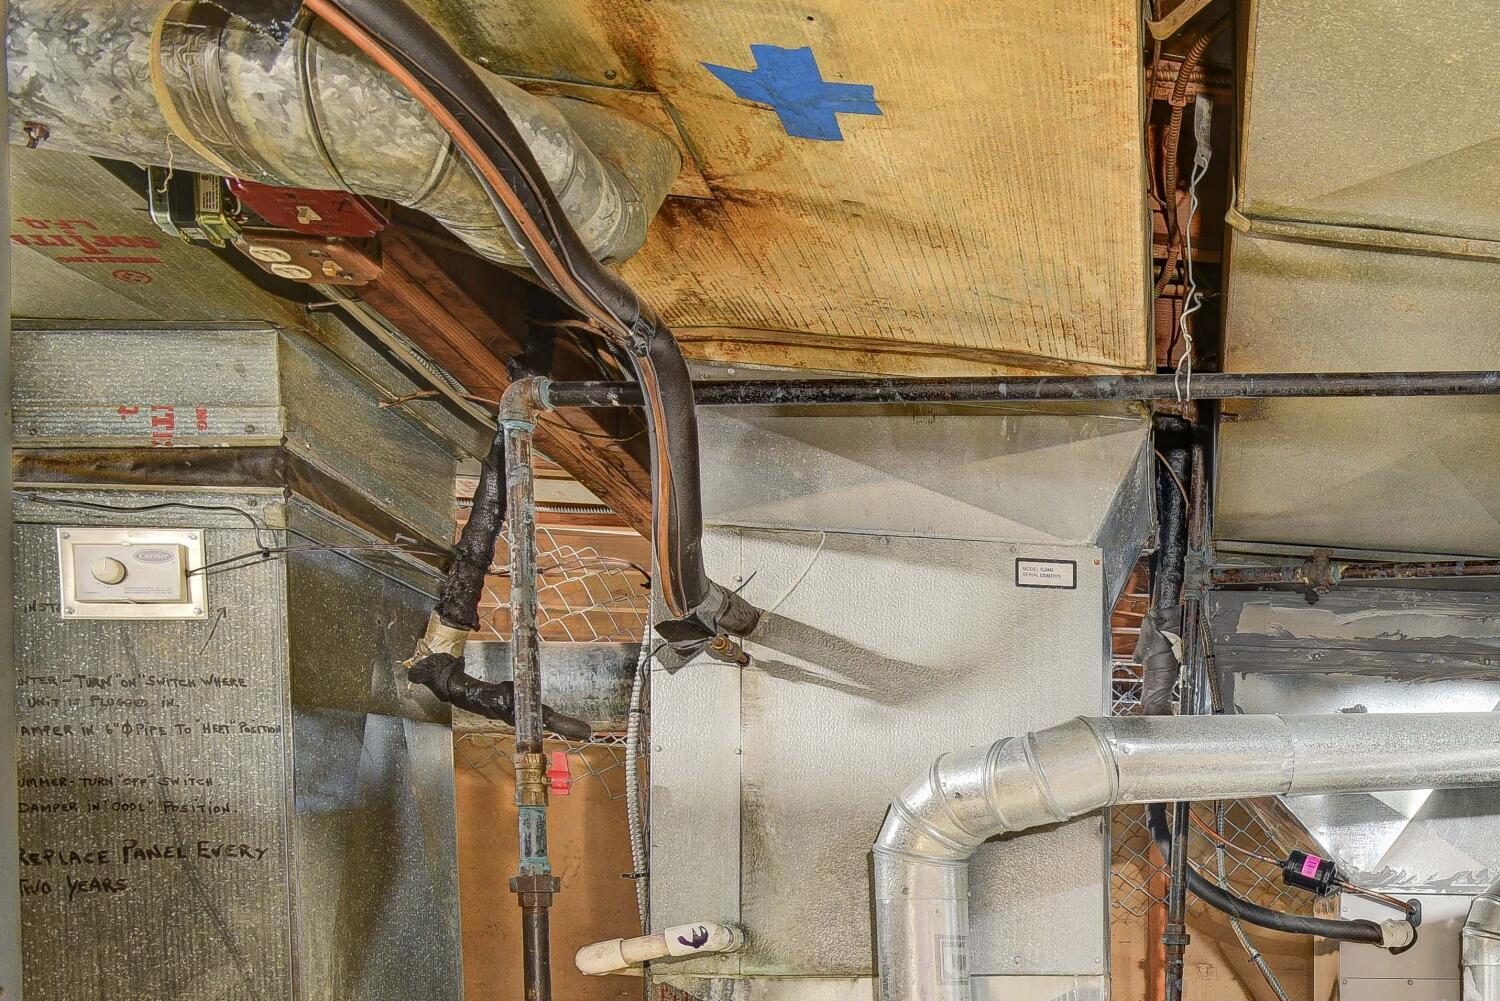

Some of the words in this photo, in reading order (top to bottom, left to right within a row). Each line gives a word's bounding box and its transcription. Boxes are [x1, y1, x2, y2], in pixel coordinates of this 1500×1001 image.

[138, 551, 170, 562] Carrier
[19, 848, 111, 867] REPLACE
[123, 839, 188, 864] PANEL
[197, 841, 269, 862] EVERY
